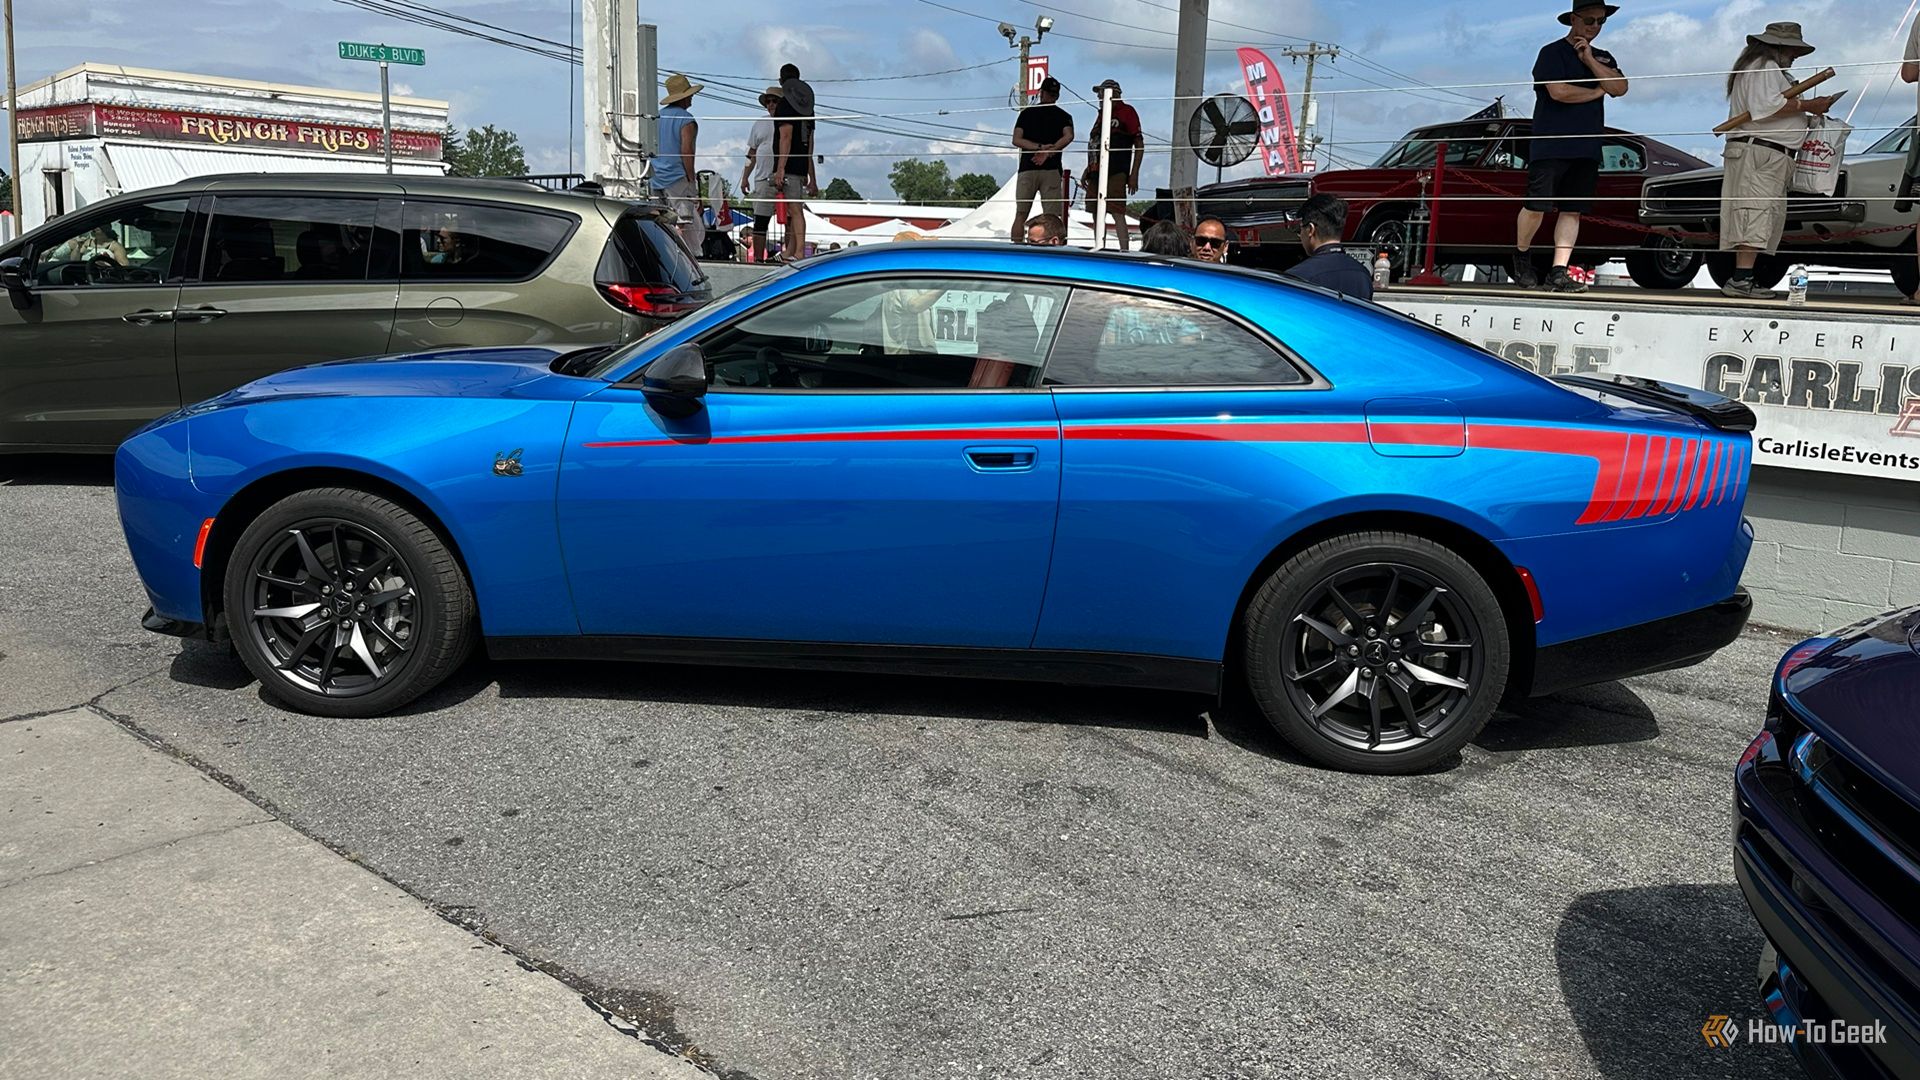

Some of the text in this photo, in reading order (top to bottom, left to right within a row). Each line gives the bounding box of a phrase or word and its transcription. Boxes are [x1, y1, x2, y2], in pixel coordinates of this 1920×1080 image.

[348, 44, 418, 62] DUKE'S BLVD
[46, 114, 69, 137] FRIES
[180, 116, 370, 152] FRENCH FRIES
